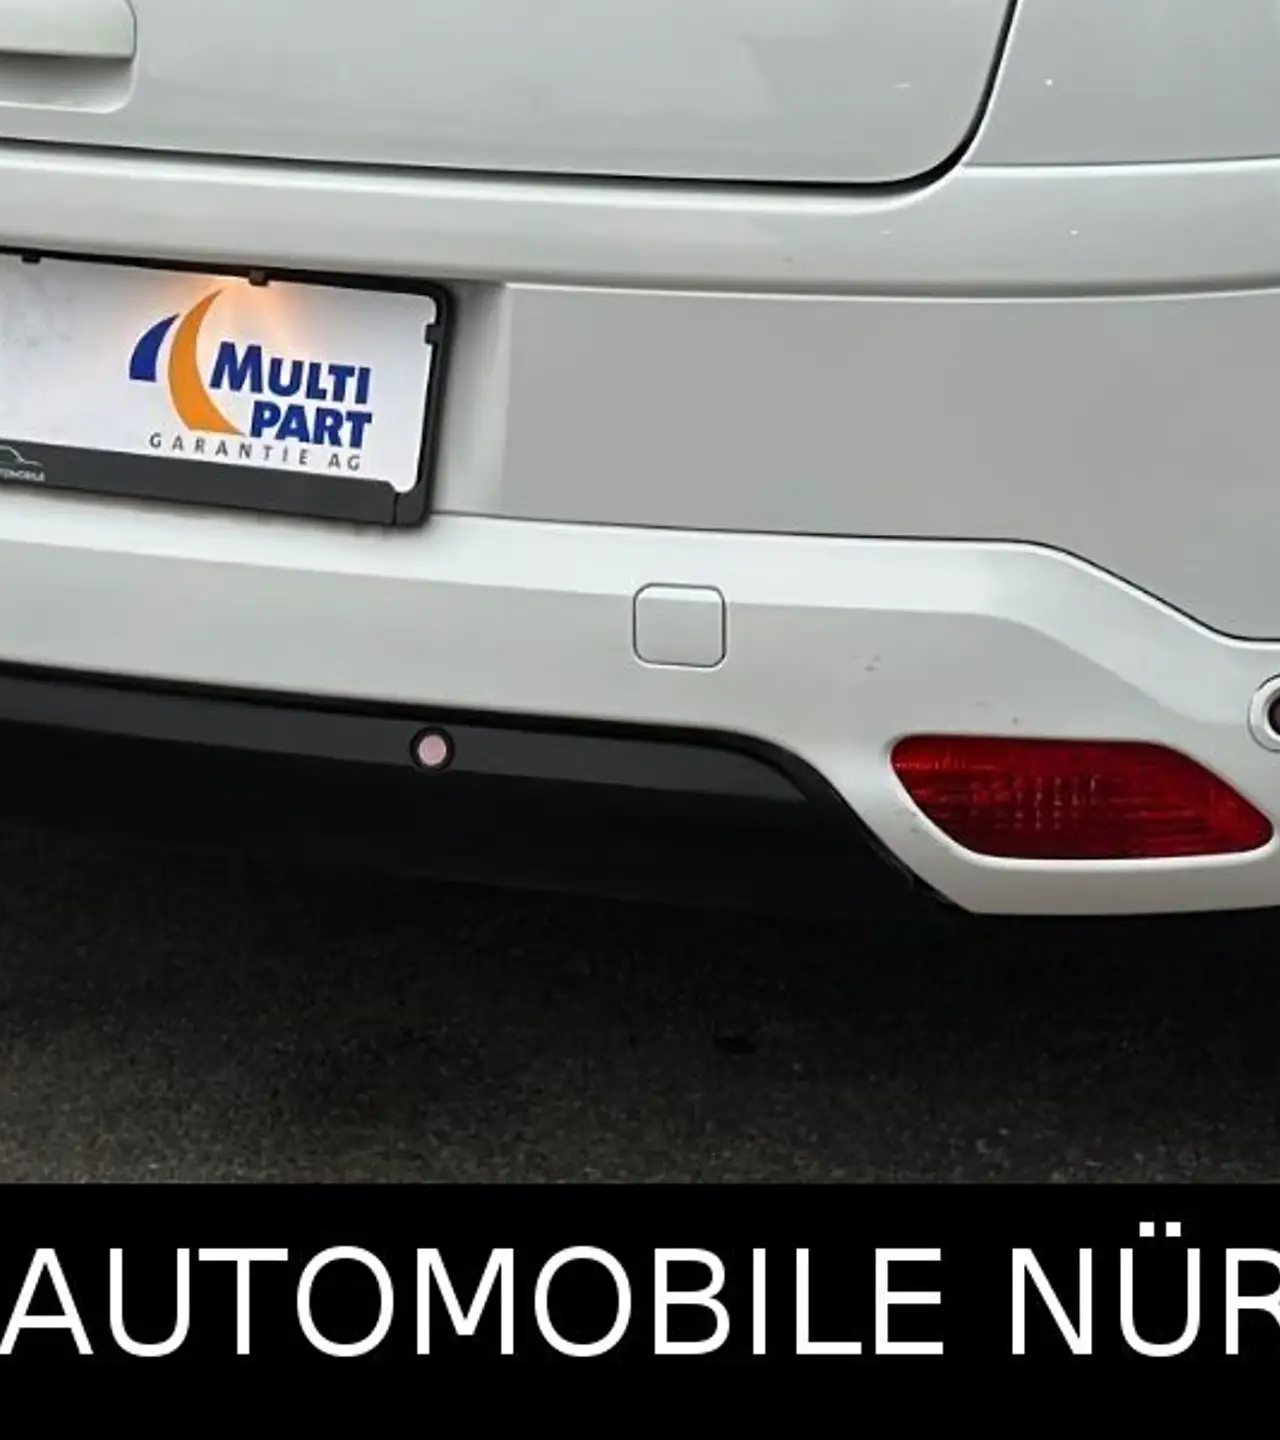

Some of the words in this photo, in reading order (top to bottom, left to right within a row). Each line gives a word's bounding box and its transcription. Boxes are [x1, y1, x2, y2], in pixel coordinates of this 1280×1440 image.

[209, 340, 373, 405] MULTI
[249, 400, 373, 450] PART
[148, 431, 309, 466] GARANTIE
[327, 452, 362, 472] AG
